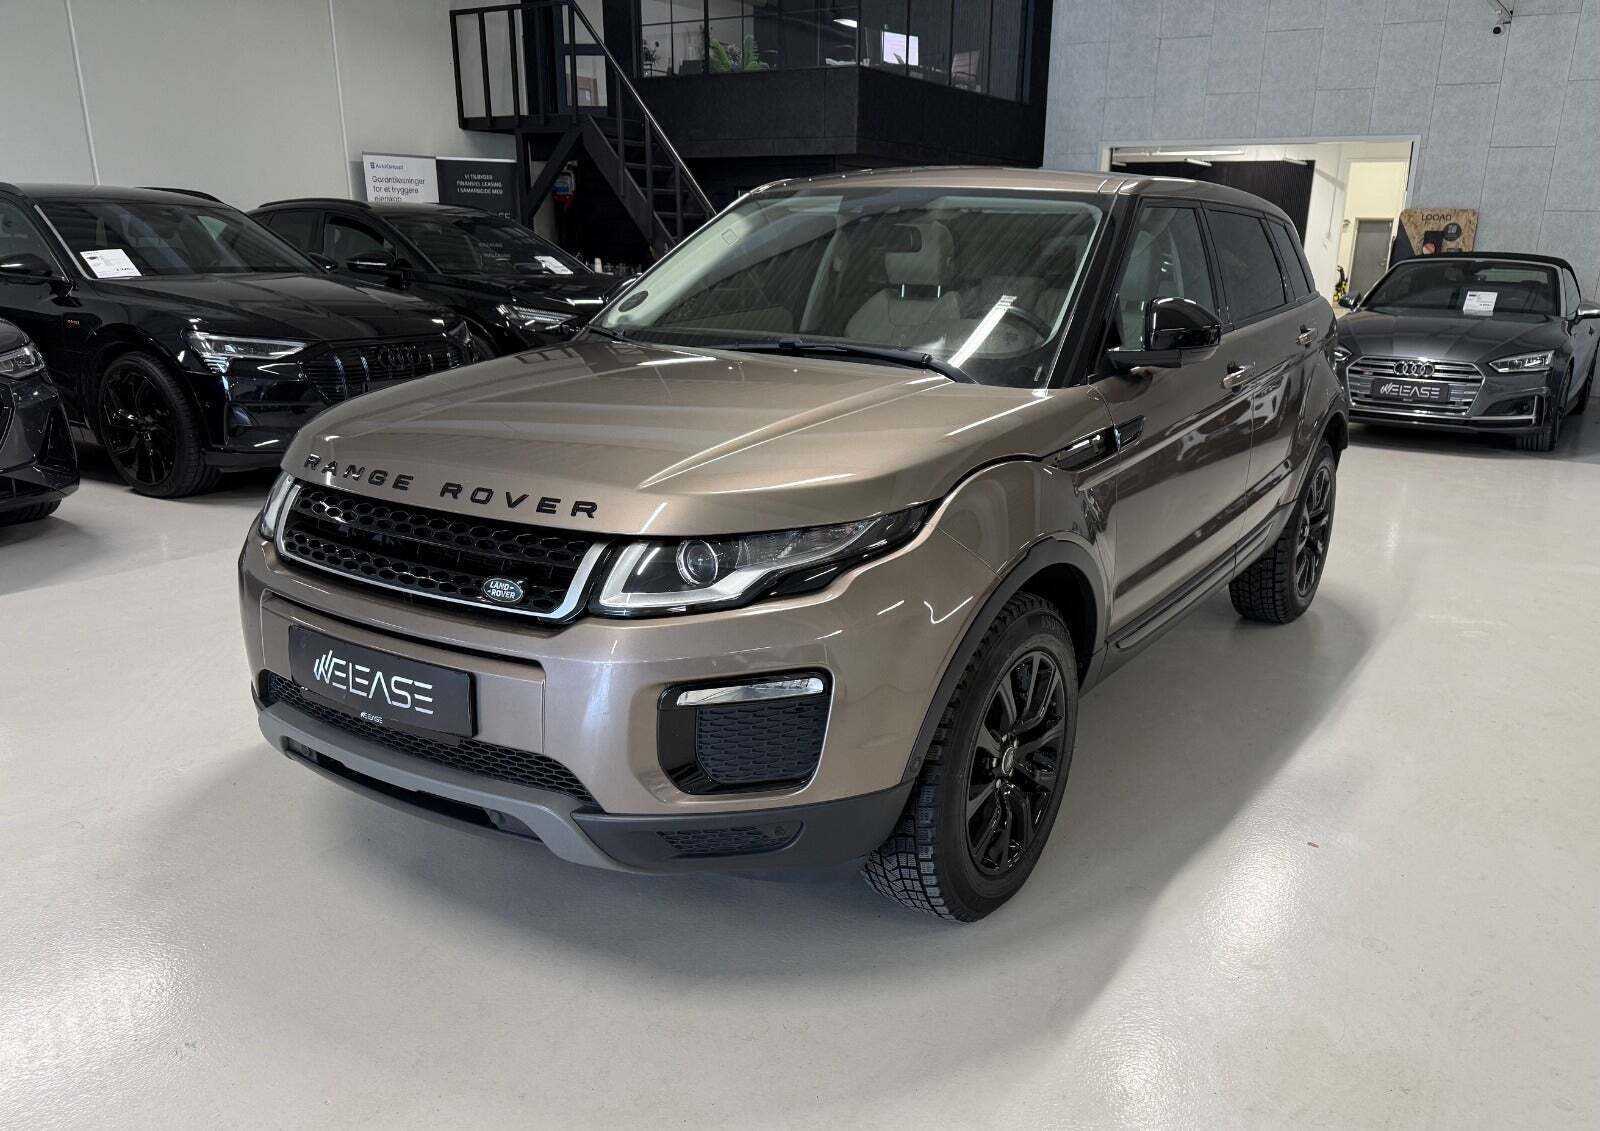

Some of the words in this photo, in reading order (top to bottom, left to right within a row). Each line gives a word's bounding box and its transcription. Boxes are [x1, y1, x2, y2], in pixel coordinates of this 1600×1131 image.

[373, 185, 382, 193] for
[392, 186, 419, 196] tryggere
[1379, 382, 1441, 399] WELEASE
[303, 453, 414, 491] RANGE
[439, 482, 599, 519] ROVER
[313, 650, 434, 715] WELEASE
